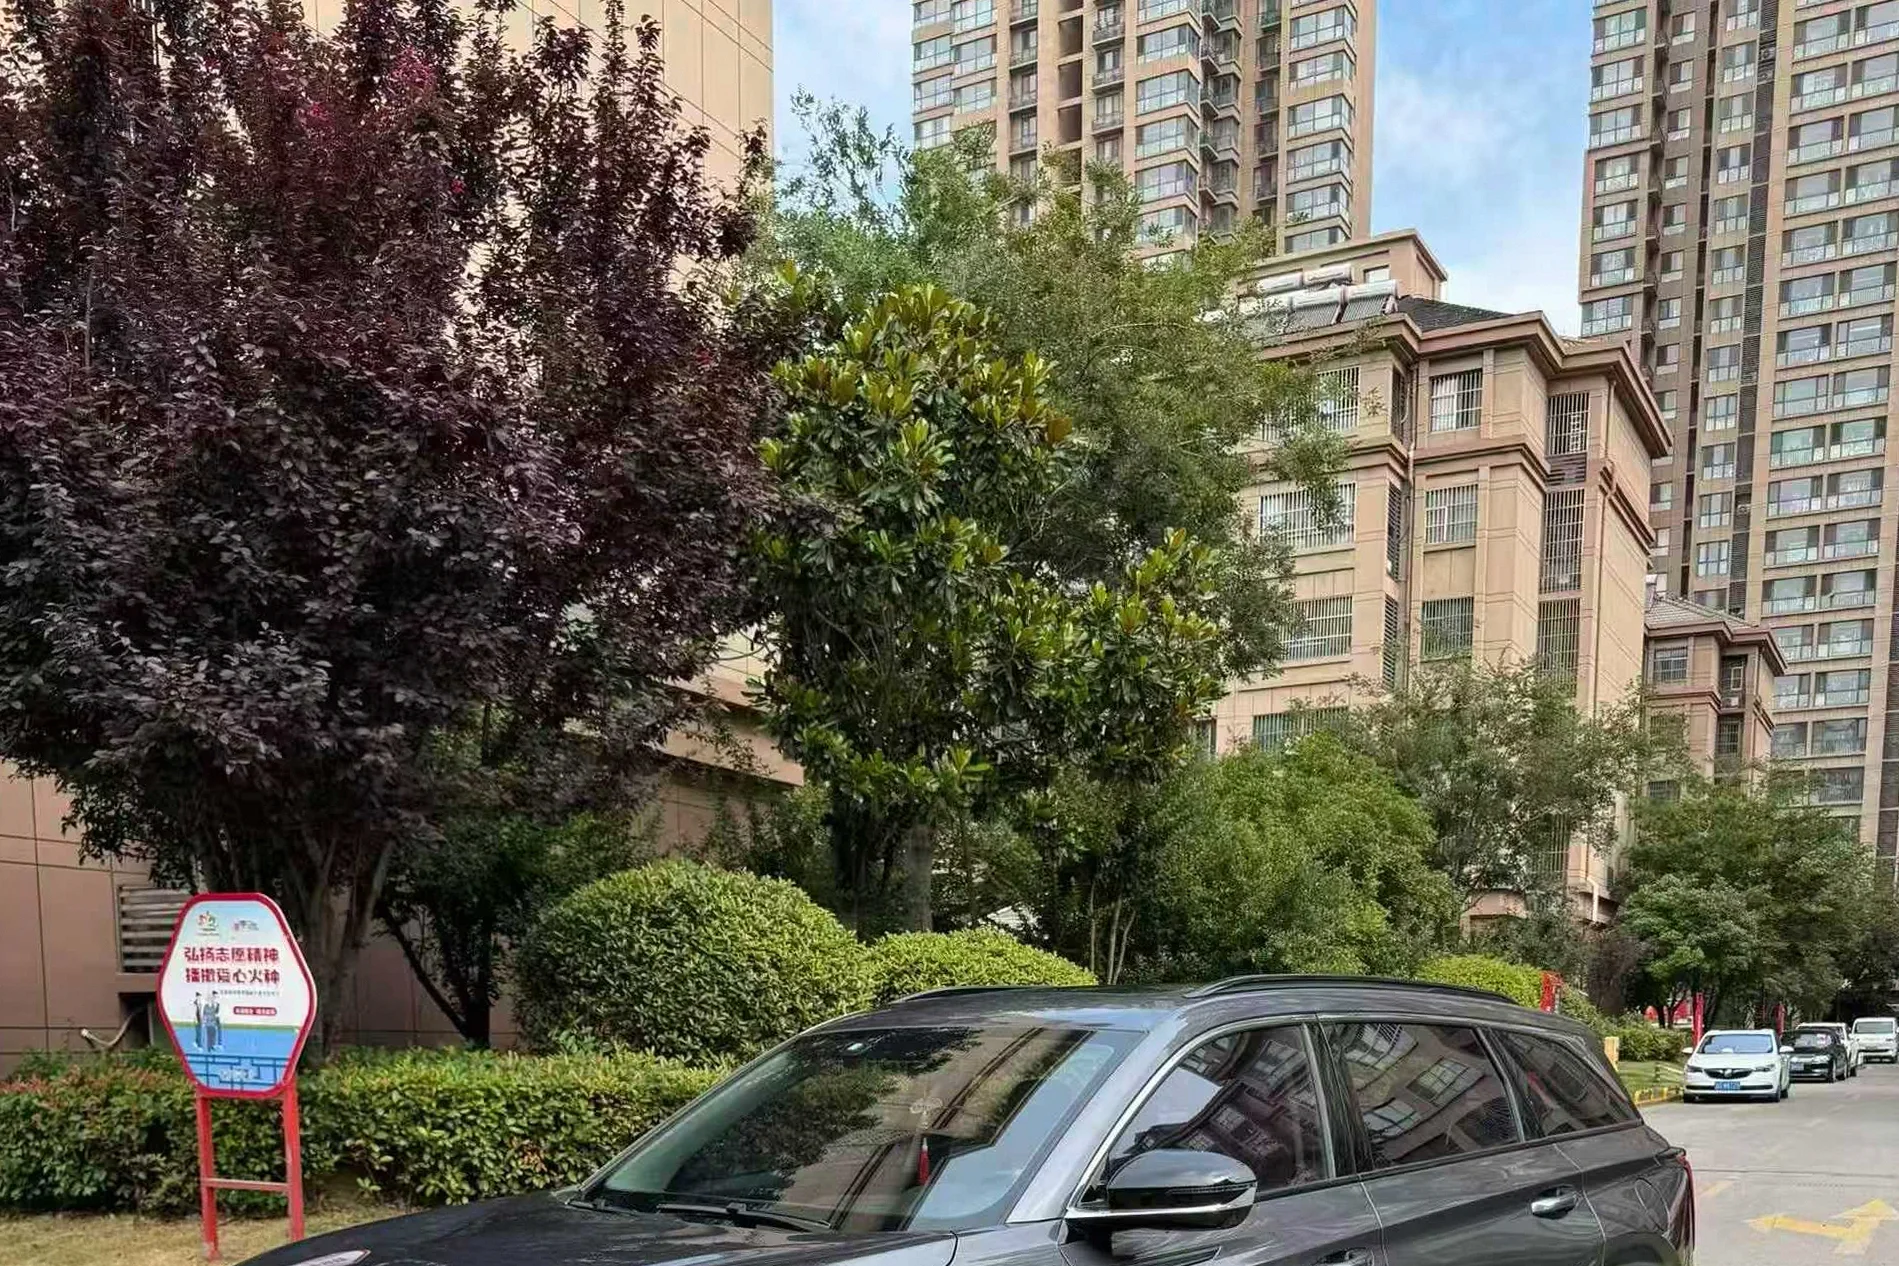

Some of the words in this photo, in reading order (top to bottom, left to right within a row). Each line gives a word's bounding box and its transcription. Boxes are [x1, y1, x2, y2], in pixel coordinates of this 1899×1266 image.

[183, 946, 279, 963] 弘扬志愿精神
[185, 968, 280, 984] 播撒爱心火种
